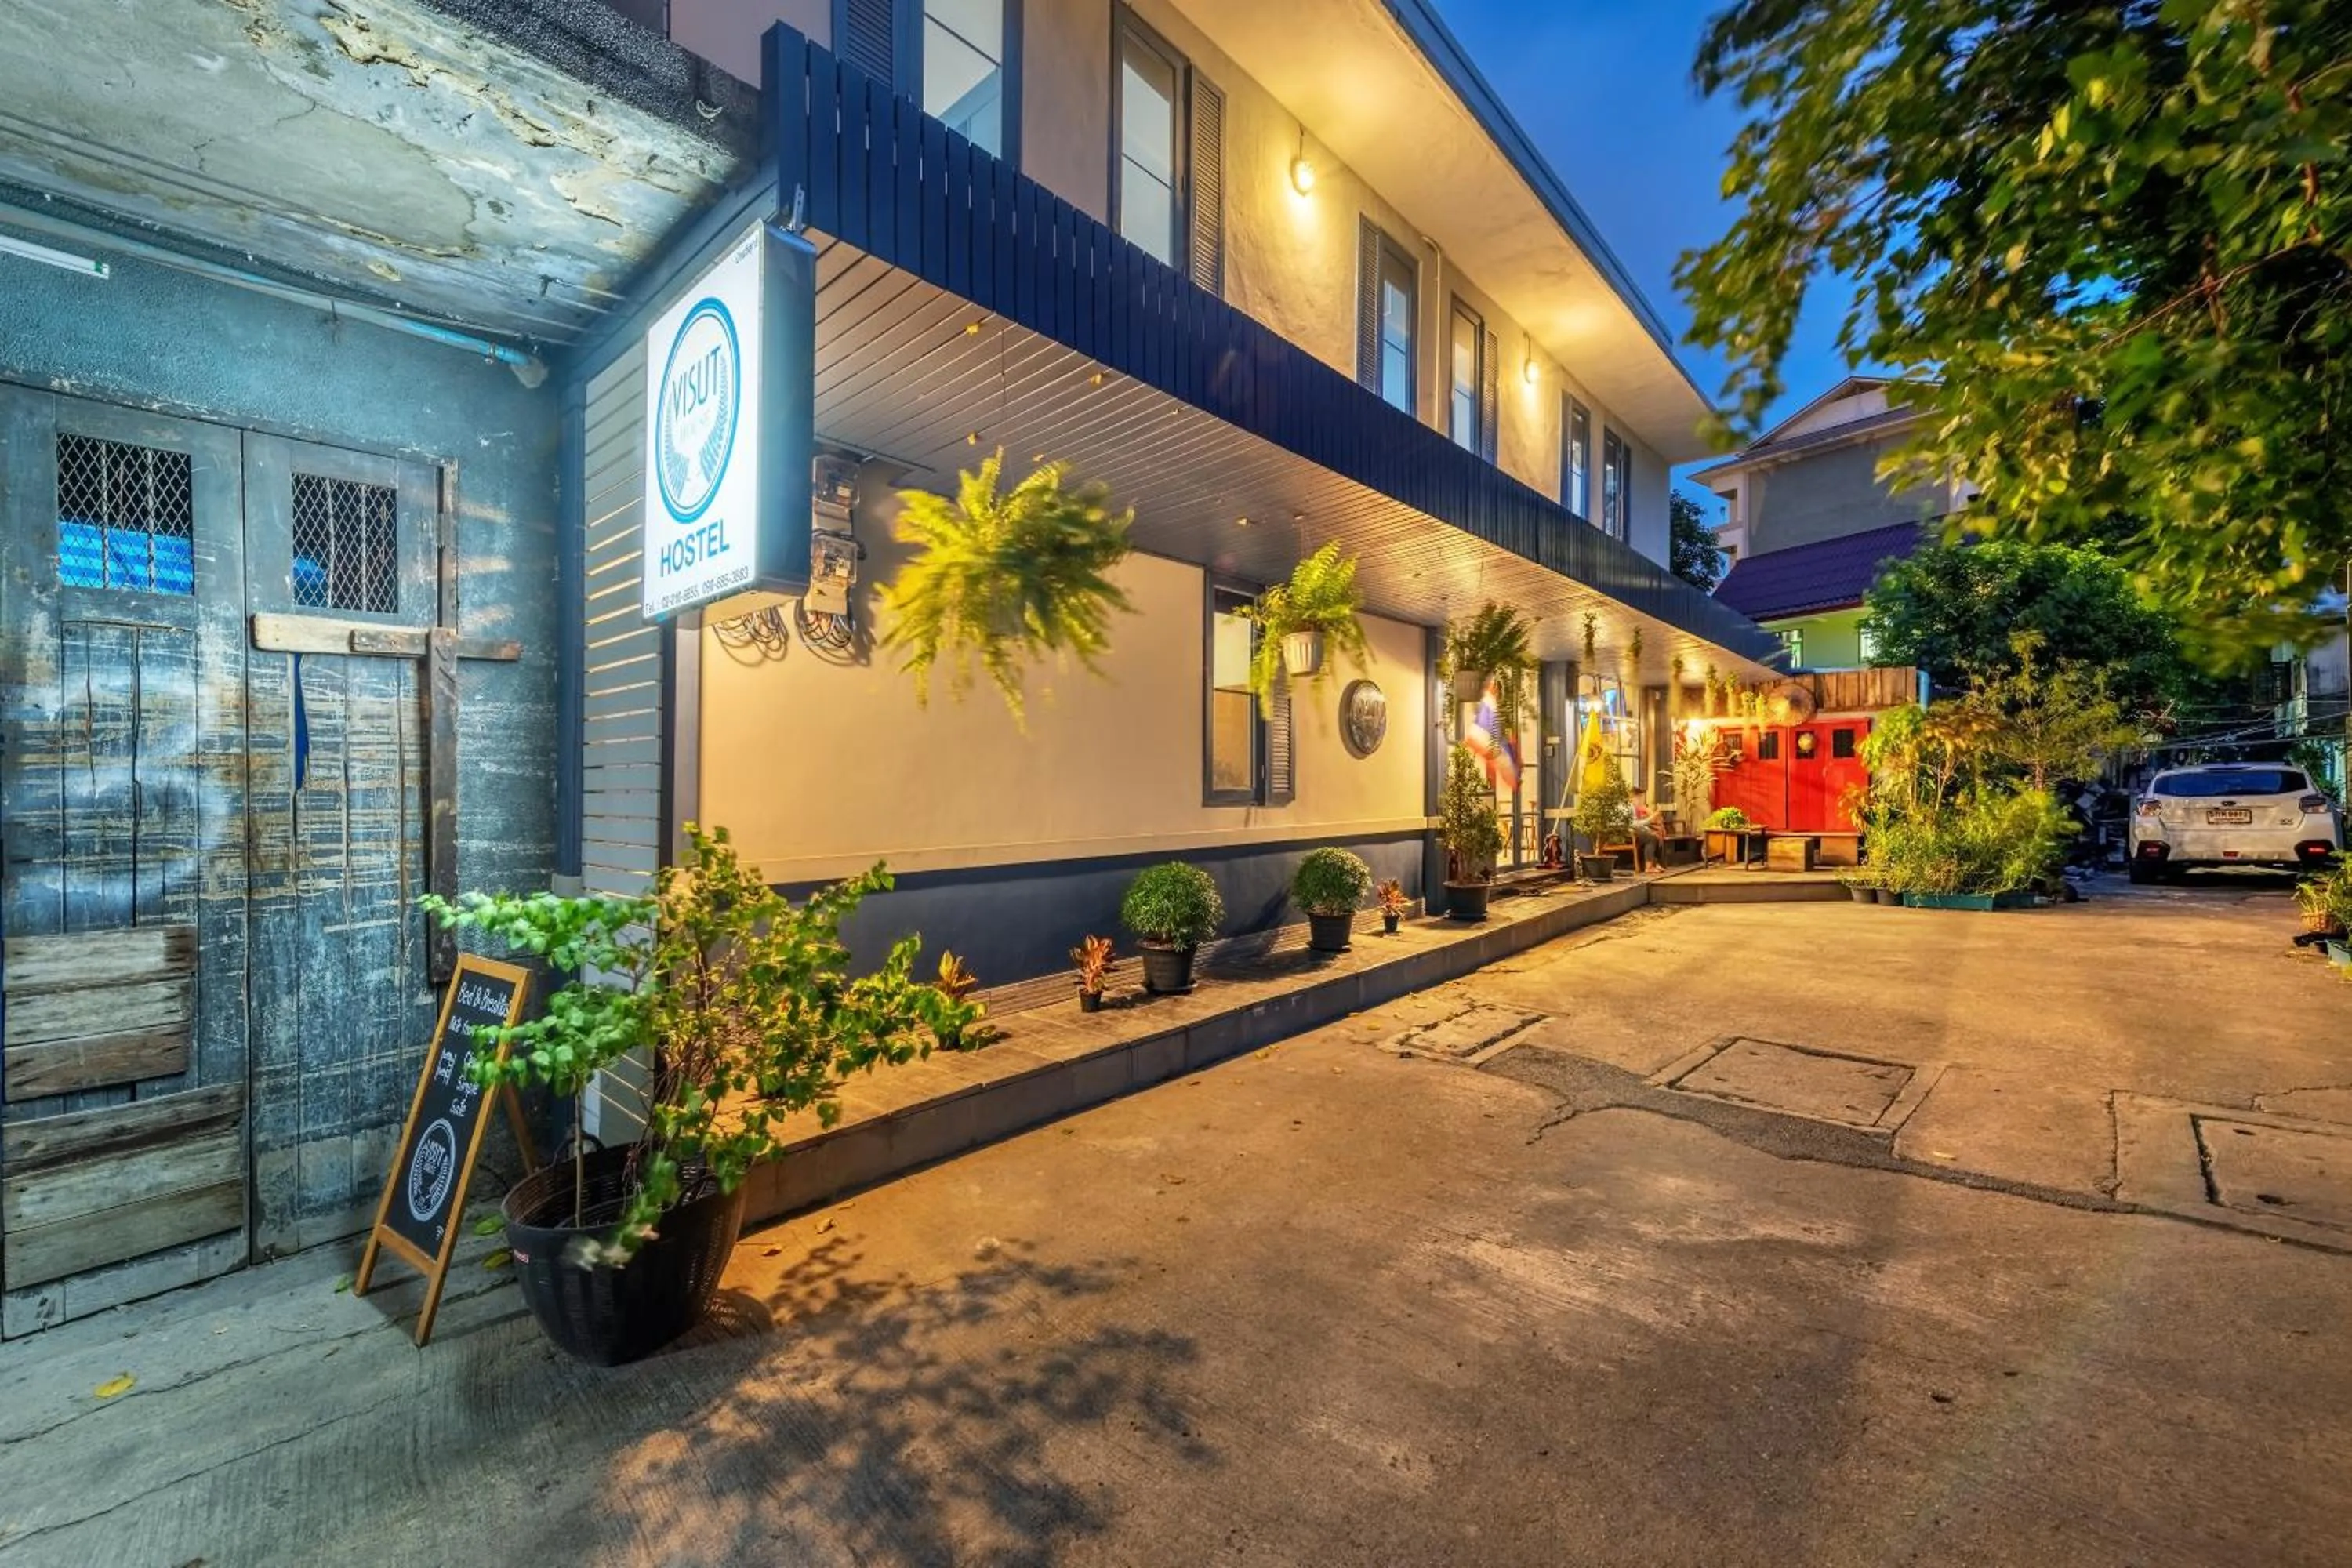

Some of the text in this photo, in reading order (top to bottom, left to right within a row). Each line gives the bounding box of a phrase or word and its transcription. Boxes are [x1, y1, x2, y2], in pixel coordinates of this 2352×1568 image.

[672, 345, 720, 421] VISUT
[660, 518, 730, 578] HOSTEL
[457, 981, 477, 1007] Bed
